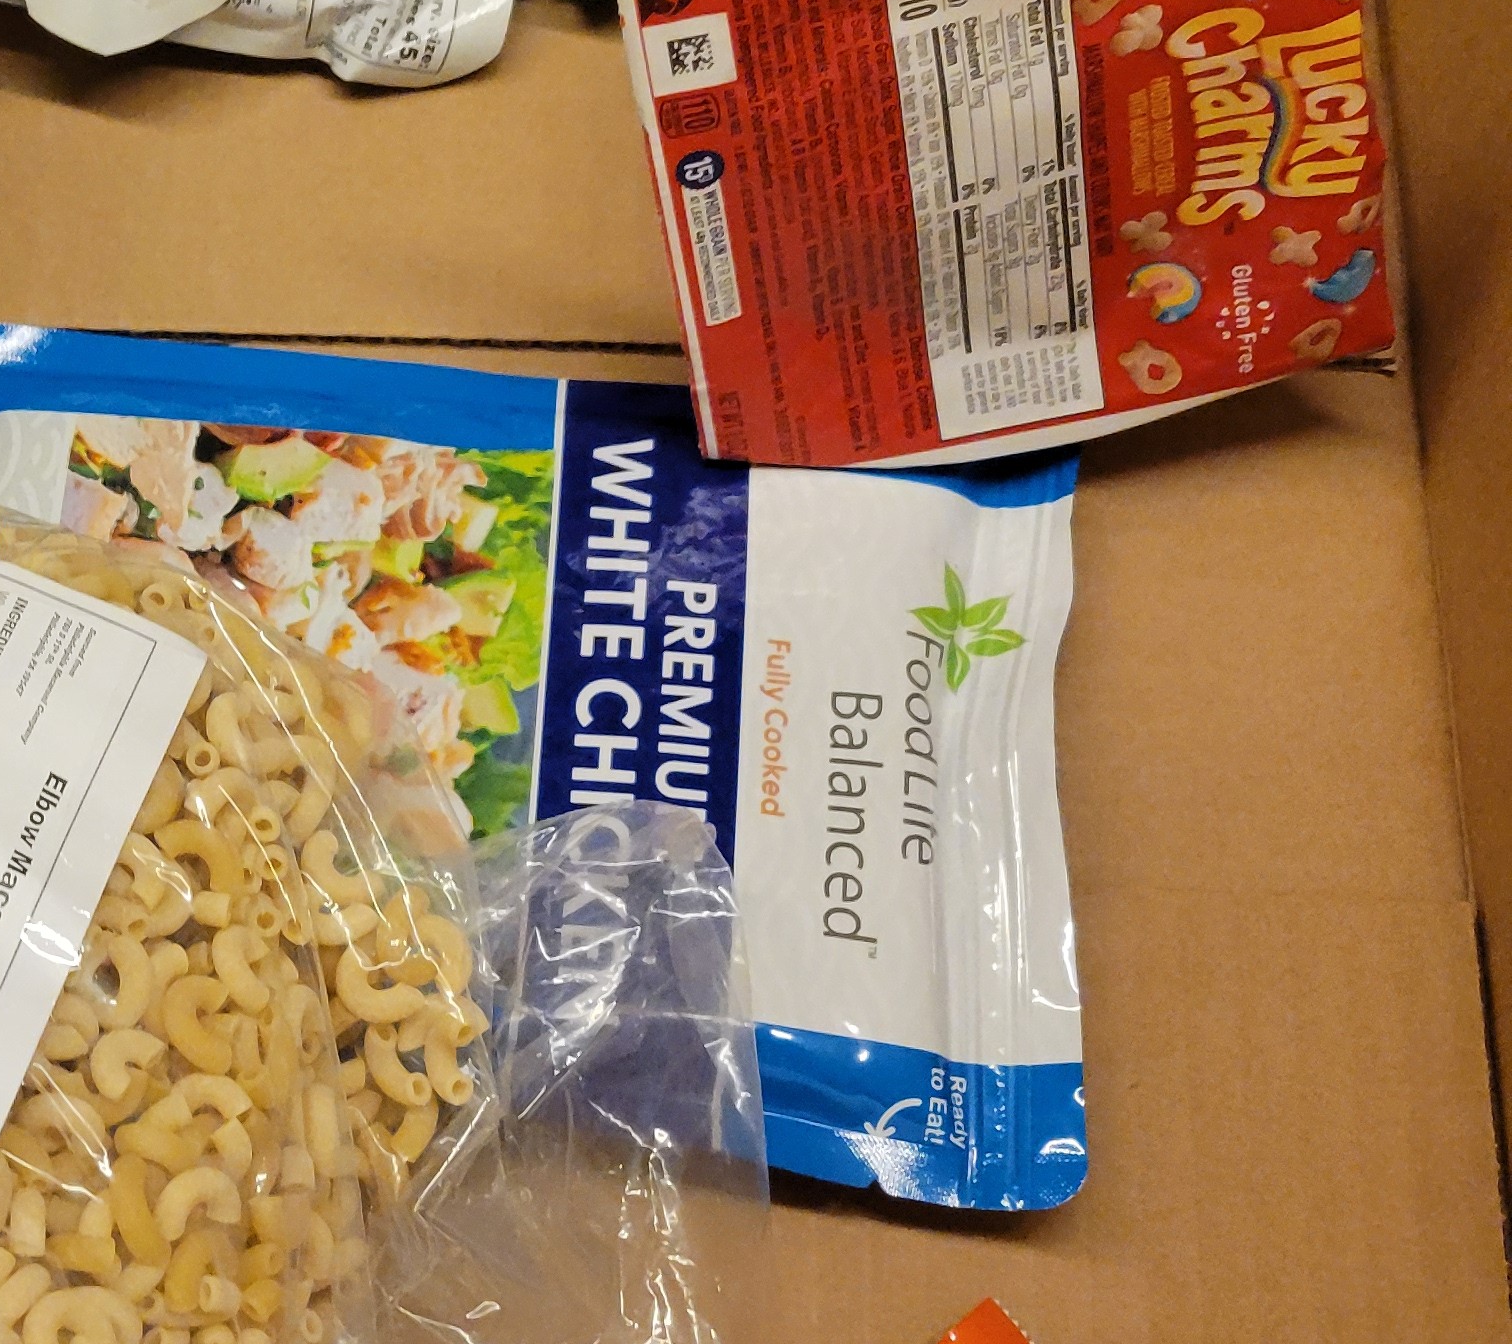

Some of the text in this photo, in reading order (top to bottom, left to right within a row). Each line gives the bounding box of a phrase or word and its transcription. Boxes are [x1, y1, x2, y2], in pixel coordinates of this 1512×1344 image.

[361, 14, 387, 58] Total
[942, 22, 960, 66] Sodium
[961, 16, 984, 80] Cholesterol
[1028, 27, 1044, 47] Fat
[1166, 7, 1277, 226] Charms
[1260, 9, 1370, 197] Lucky
[700, 190, 729, 256] WHOLE GRAIN
[1231, 264, 1255, 374] Gluten Free
[580, 439, 654, 661] WHITE
[760, 638, 792, 816] Fully Cooked
[16, 771, 69, 849] Elbow
[823, 690, 883, 945] Balanced
[923, 1067, 948, 1148] to Eat!
[948, 1074, 968, 1152] Ready
